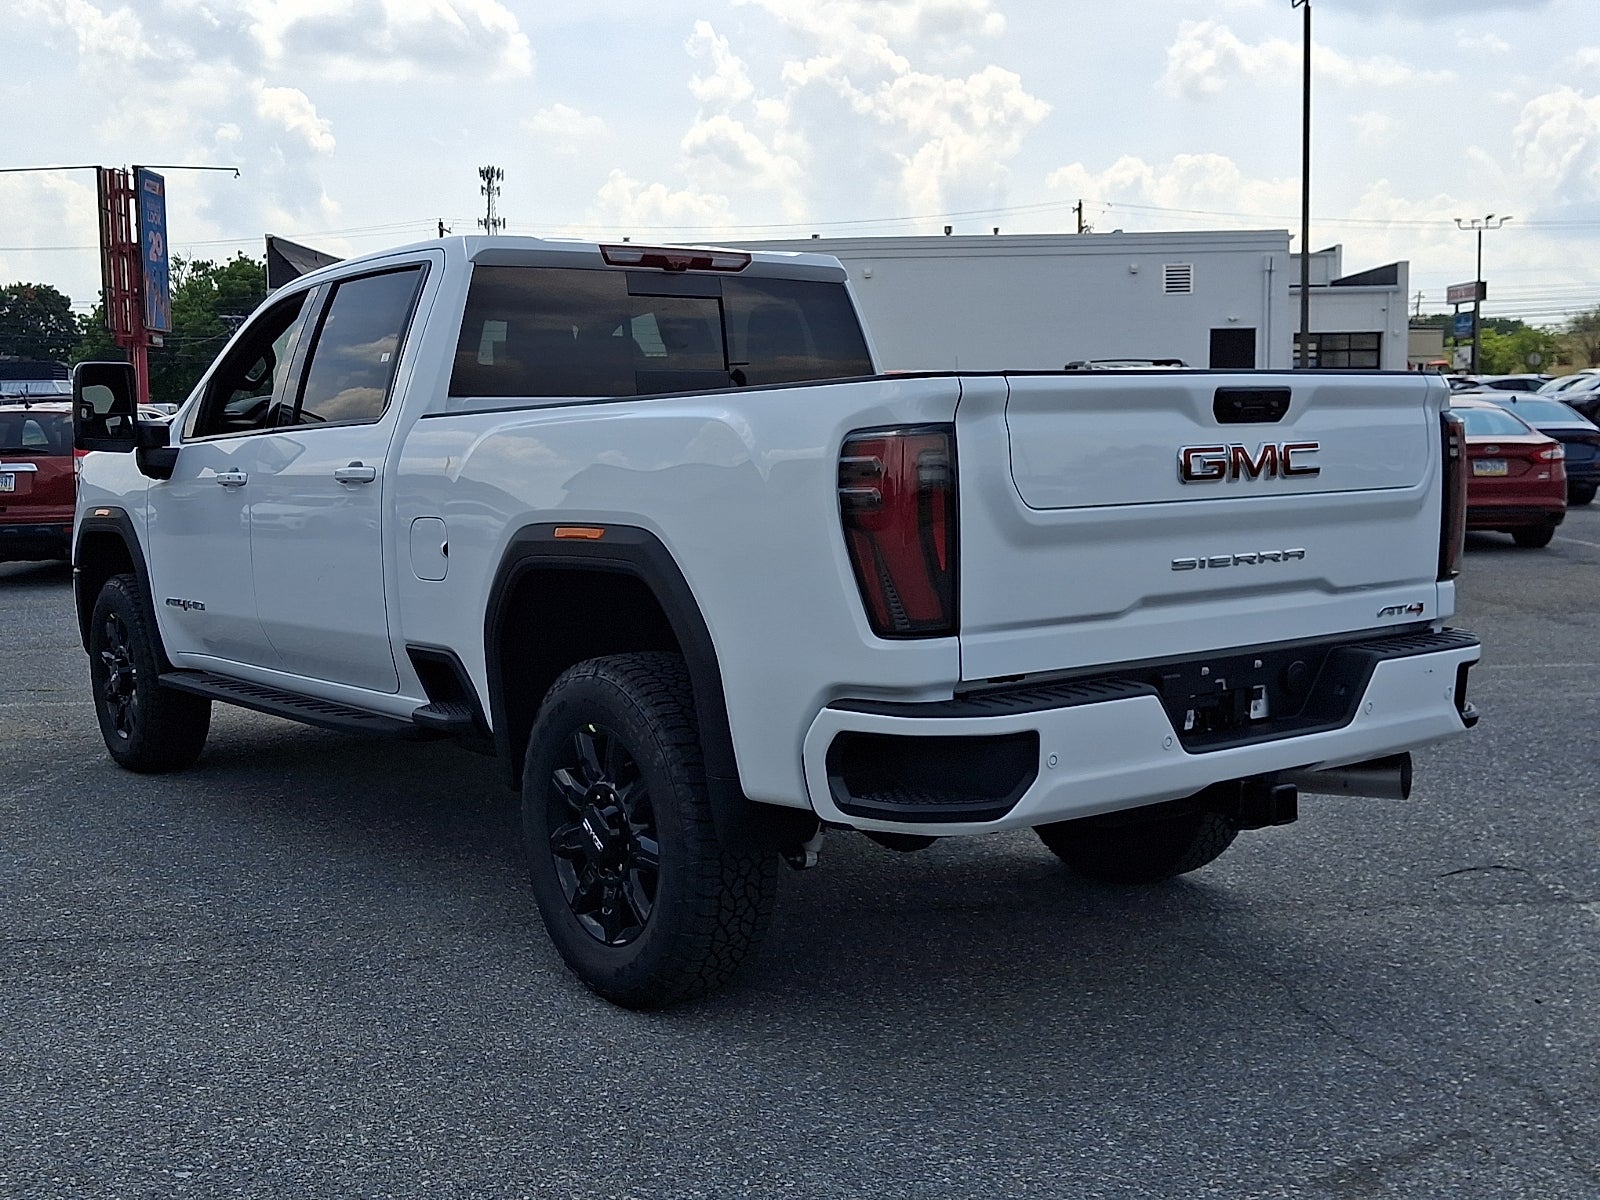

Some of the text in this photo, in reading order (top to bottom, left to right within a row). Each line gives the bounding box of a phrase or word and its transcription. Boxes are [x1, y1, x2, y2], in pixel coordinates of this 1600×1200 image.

[1178, 441, 1321, 485] GMC
[1171, 548, 1305, 571] SIERRA
[1377, 601, 1424, 617] AT4
